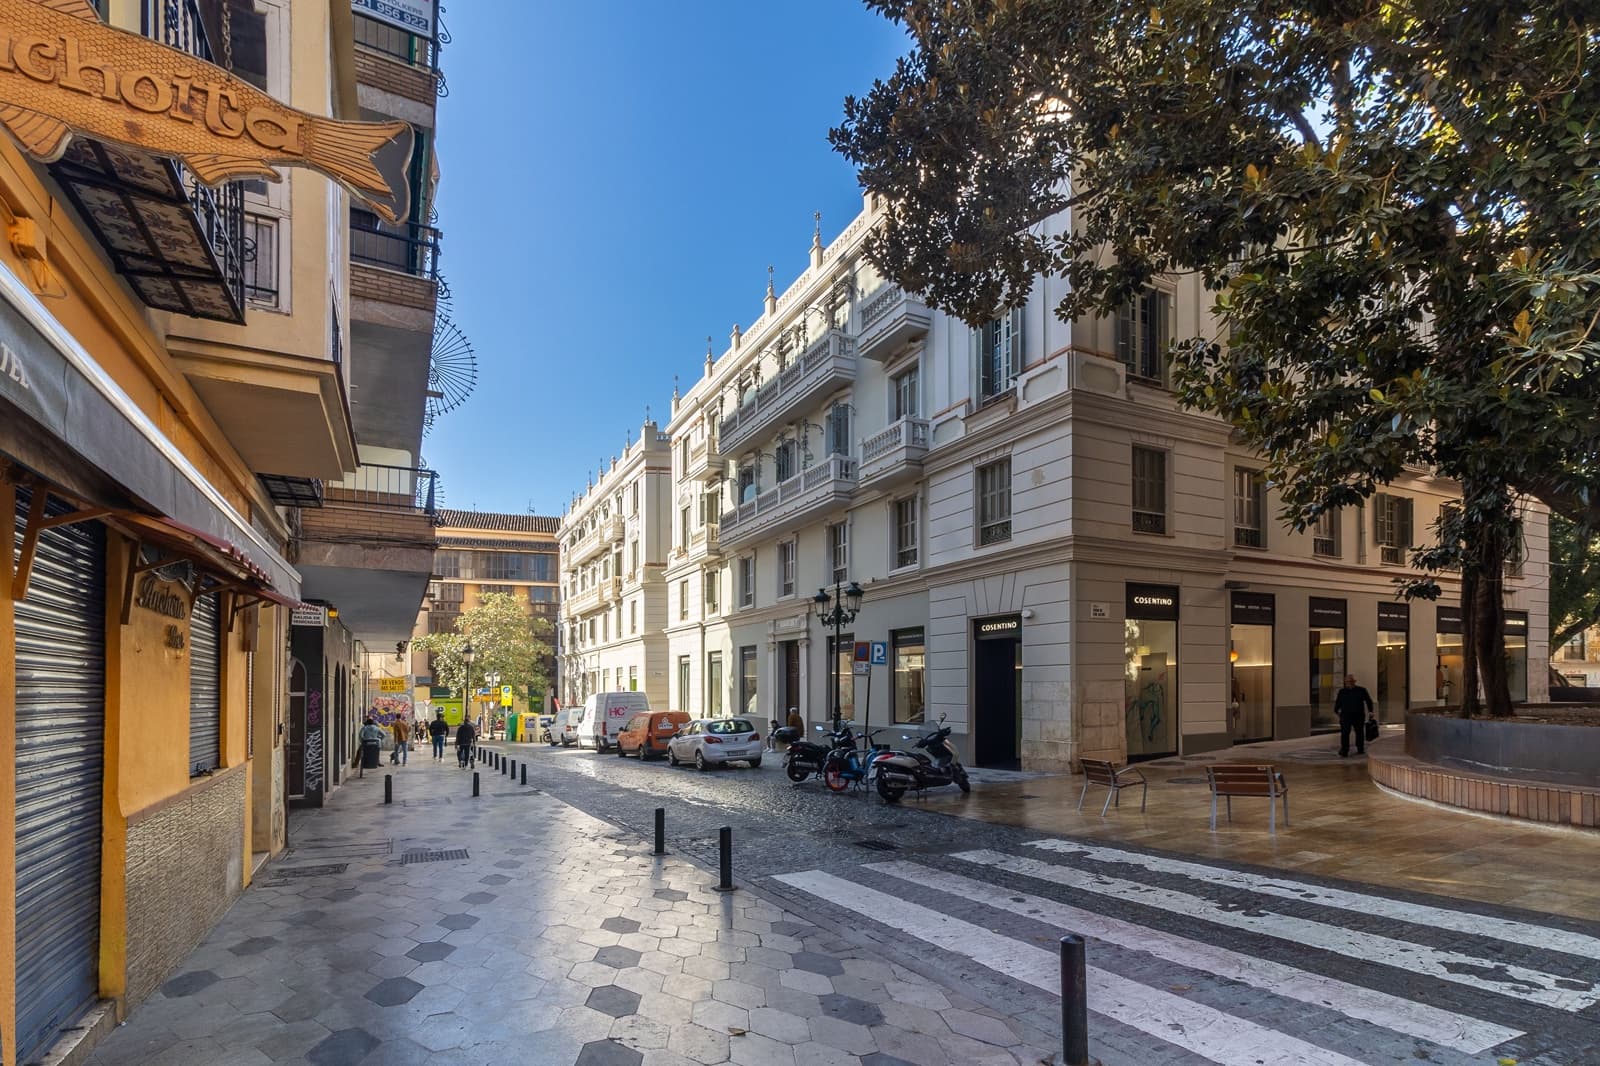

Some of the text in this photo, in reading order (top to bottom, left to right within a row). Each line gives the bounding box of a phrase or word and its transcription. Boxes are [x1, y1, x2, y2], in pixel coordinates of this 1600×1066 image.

[376, 2, 401, 18] 956
[403, 13, 426, 29] 922
[1134, 596, 1173, 606] COSENTINO
[981, 621, 1018, 632] COSENTINO
